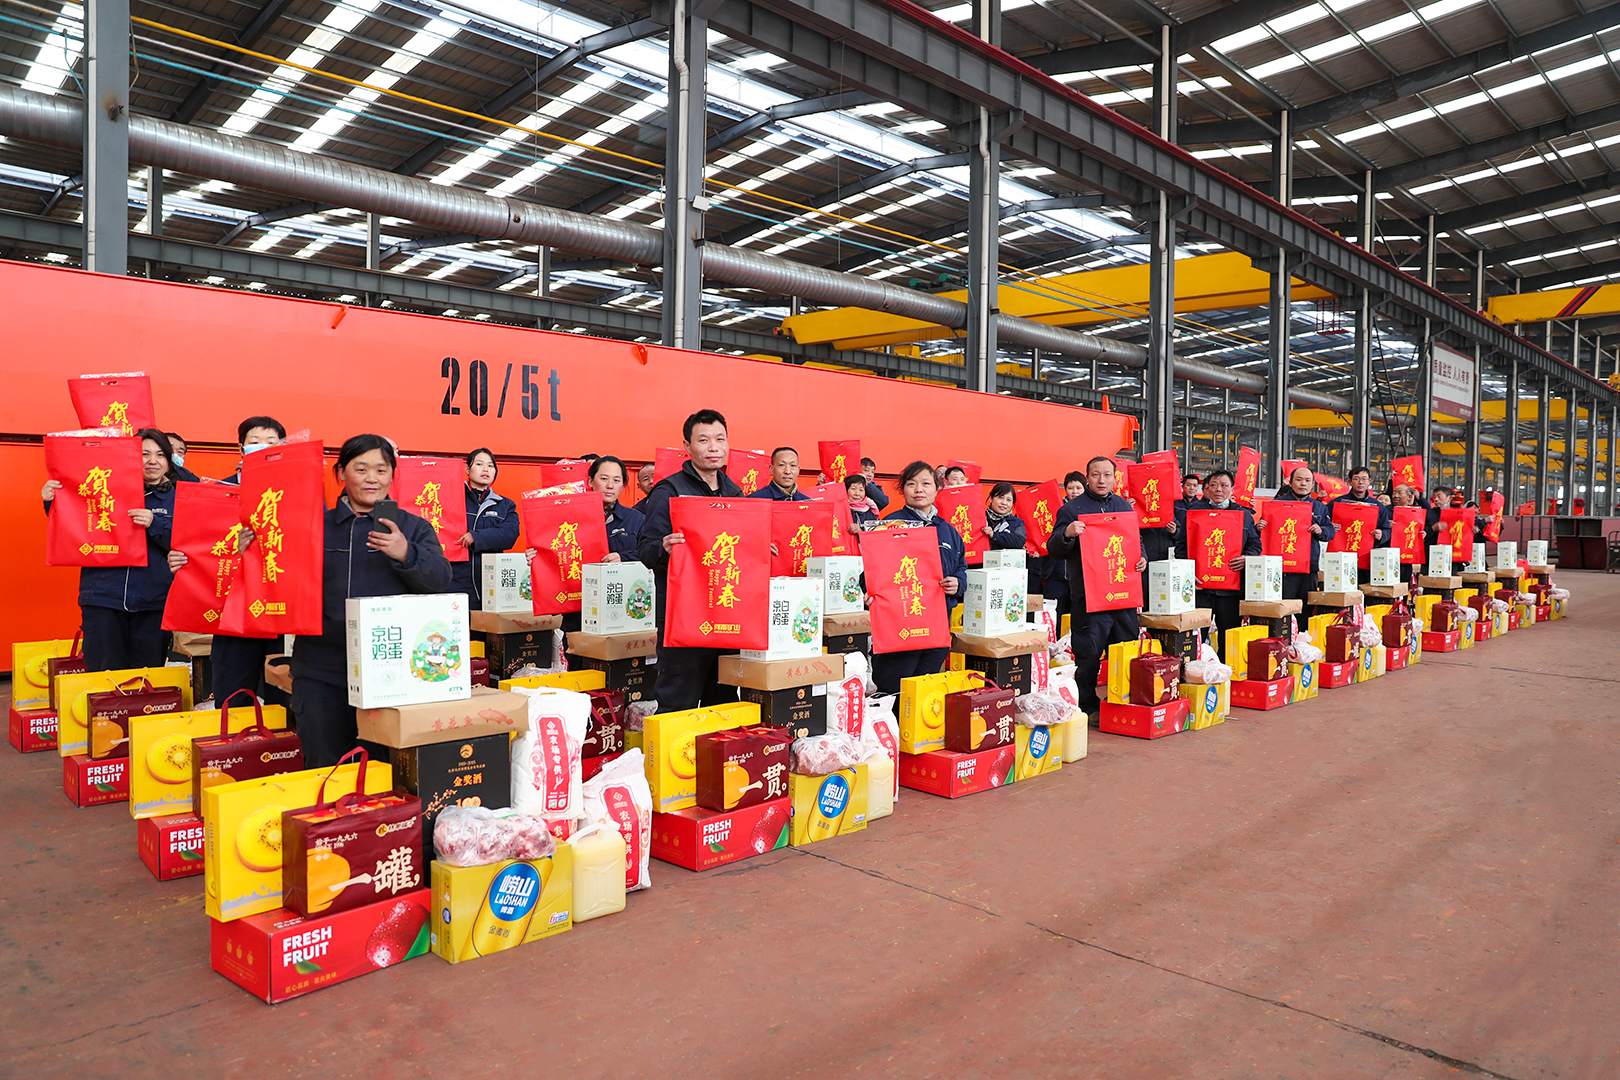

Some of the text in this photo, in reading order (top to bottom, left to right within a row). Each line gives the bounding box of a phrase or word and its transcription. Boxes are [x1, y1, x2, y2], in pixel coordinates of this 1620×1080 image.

[441, 357, 561, 421] 20/5t
[371, 625, 402, 642] 京白
[372, 642, 403, 661] 鸡蛋
[432, 715, 474, 732] 黄花鱼
[549, 735, 563, 775] 农场专供
[87, 763, 124, 776] FRESH
[957, 758, 977, 770] FRESH
[87, 773, 121, 785] FRUIT
[453, 773, 483, 787] 金奖酒
[957, 767, 975, 779] FRUIT
[824, 783, 846, 801] 崂山
[170, 826, 205, 842] FRES
[703, 819, 732, 835] FRESH
[703, 830, 730, 846] FRUIT
[499, 875, 536, 896] 崂山
[494, 893, 529, 907] LAOSHAN
[500, 906, 515, 915] 啤酒
[283, 926, 332, 952] FRESH
[283, 941, 329, 967] FRUIT
